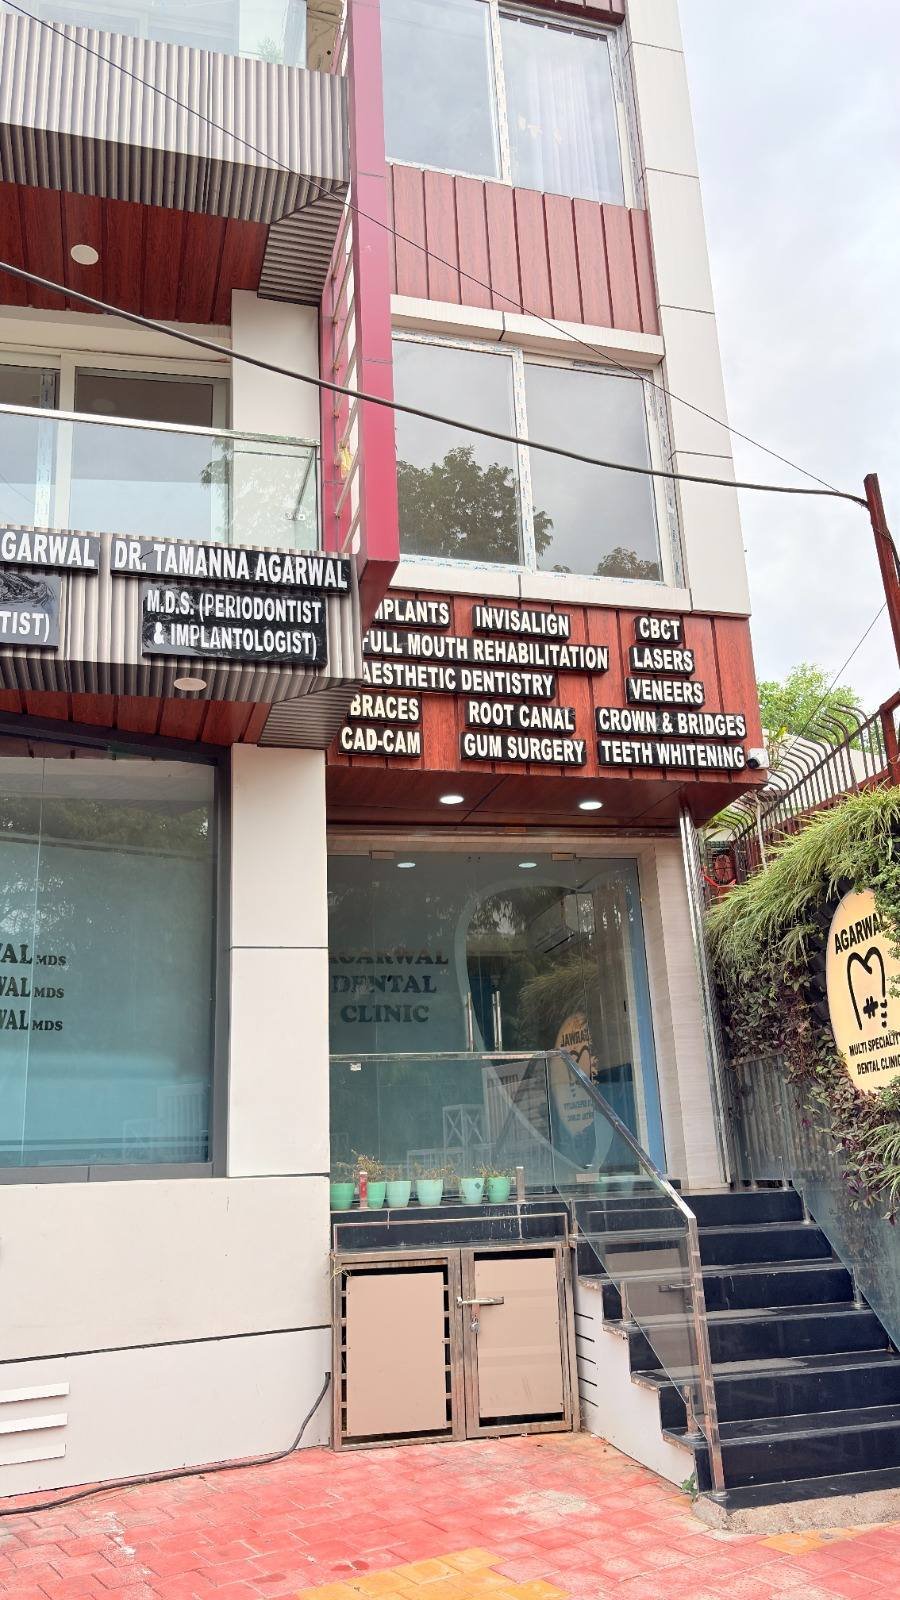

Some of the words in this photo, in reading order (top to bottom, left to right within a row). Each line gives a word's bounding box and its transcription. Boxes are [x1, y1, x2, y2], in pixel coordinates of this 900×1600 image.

[114, 540, 147, 571] DR.
[154, 543, 250, 580] TAMANNA
[255, 553, 348, 589] AGARWAL
[147, 589, 195, 615] M.D.S.
[199, 592, 322, 624] (PERIODONTIST
[374, 598, 450, 625] PLANTS
[0, 610, 50, 642] TIST)
[475, 606, 569, 637] INVISALIGN
[639, 617, 680, 641] CBCT
[153, 621, 165, 645] &
[170, 623, 317, 661] IMPLANTOLOGIST)
[407, 633, 468, 660] MOUTH
[473, 639, 608, 670] REHABILITATION
[633, 647, 693, 671] LASERS
[362, 661, 456, 690] AESTHETIC
[461, 669, 553, 696] DENTISTRY
[630, 678, 704, 704] VENEERS
[350, 694, 420, 721] BRACES
[469, 701, 514, 726] ROOT
[519, 705, 575, 731] CANAL
[599, 708, 657, 733] CROWN
[662, 712, 673, 734] &
[677, 712, 747, 737] BRIDGES
[341, 726, 421, 754] CAD-CAM
[464, 733, 503, 758] GUM
[507, 736, 585, 763] SURGERY
[601, 740, 653, 764] TEETH
[655, 743, 745, 768] WHITENING
[0, 943, 33, 965] AL
[36, 954, 67, 966] MDS
[34, 987, 65, 999] MDS
[331, 974, 438, 994] DENTAL
[32, 1020, 63, 1032] MDS
[340, 1004, 430, 1023] CLINIC
[849, 1041, 868, 1057] MULTI
[868, 1032, 900, 1053] SPECIALIT
[857, 1059, 880, 1075] DENTAL
